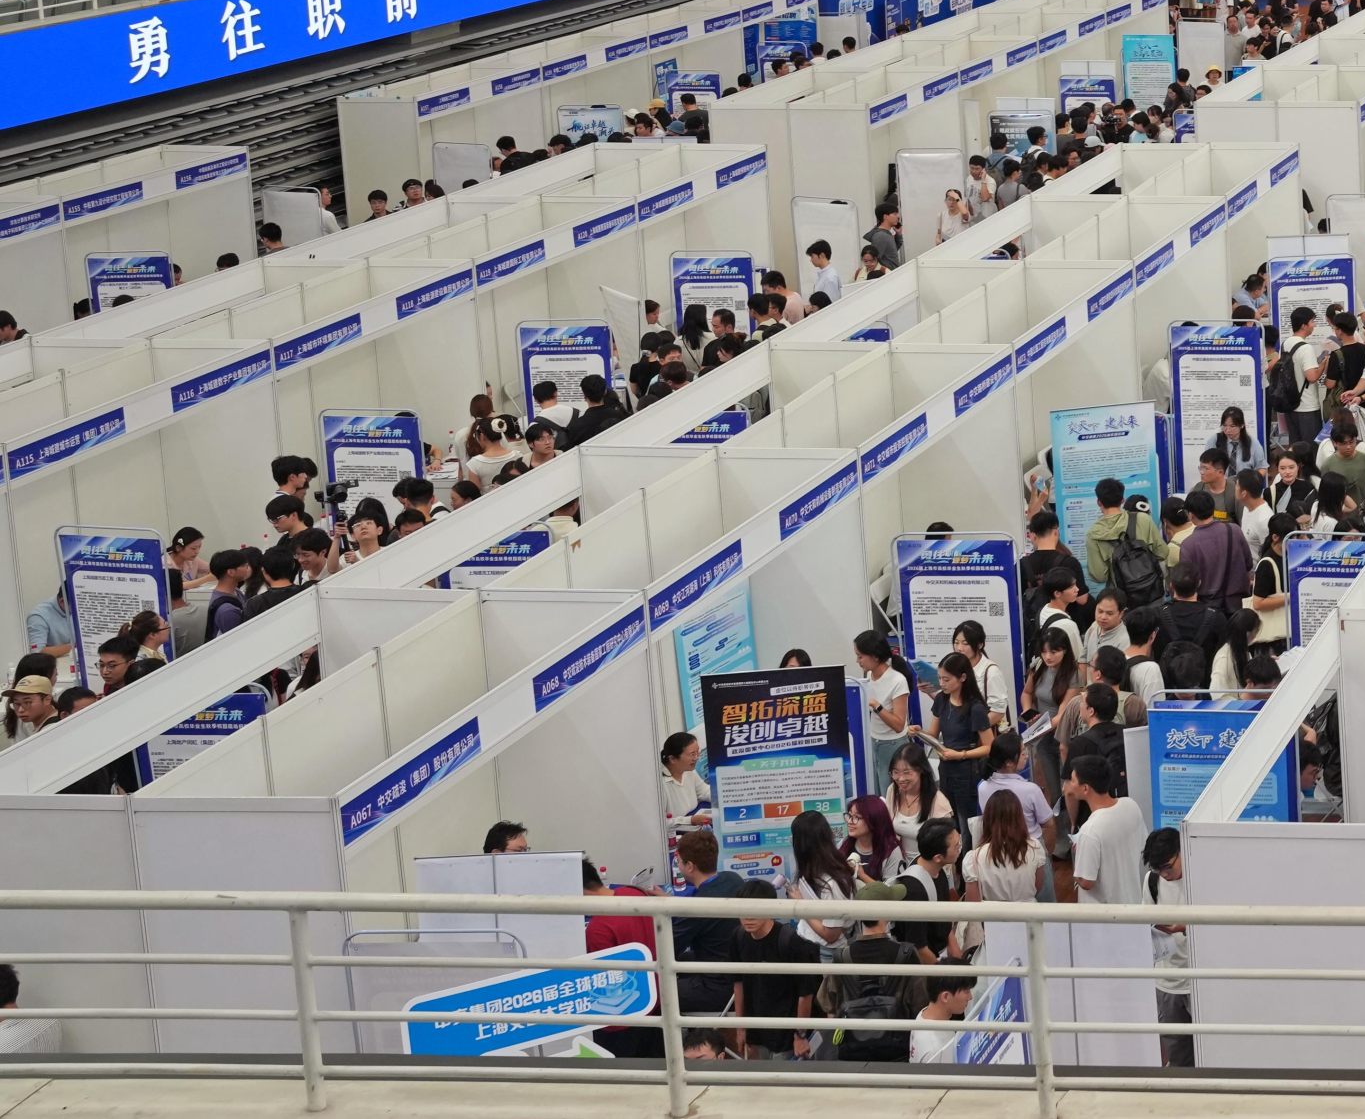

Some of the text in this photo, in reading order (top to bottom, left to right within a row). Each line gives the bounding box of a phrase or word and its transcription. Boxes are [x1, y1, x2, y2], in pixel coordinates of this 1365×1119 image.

[68, 203, 80, 214] A155
[479, 267, 490, 279] A119
[401, 298, 413, 311] A118
[279, 348, 293, 362] A117
[178, 388, 194, 403] A116
[15, 452, 34, 470] A115
[785, 509, 797, 529] A070
[654, 598, 669, 620] A069
[541, 673, 559, 698] A068
[722, 693, 828, 724] 智拓深蓝
[723, 714, 829, 746] 浚创卓越
[1166, 728, 1246, 750] 交天下 建
[349, 731, 474, 830] A067 中交疏浚（集团）股份有限公司
[739, 801, 830, 819] 2 17 38
